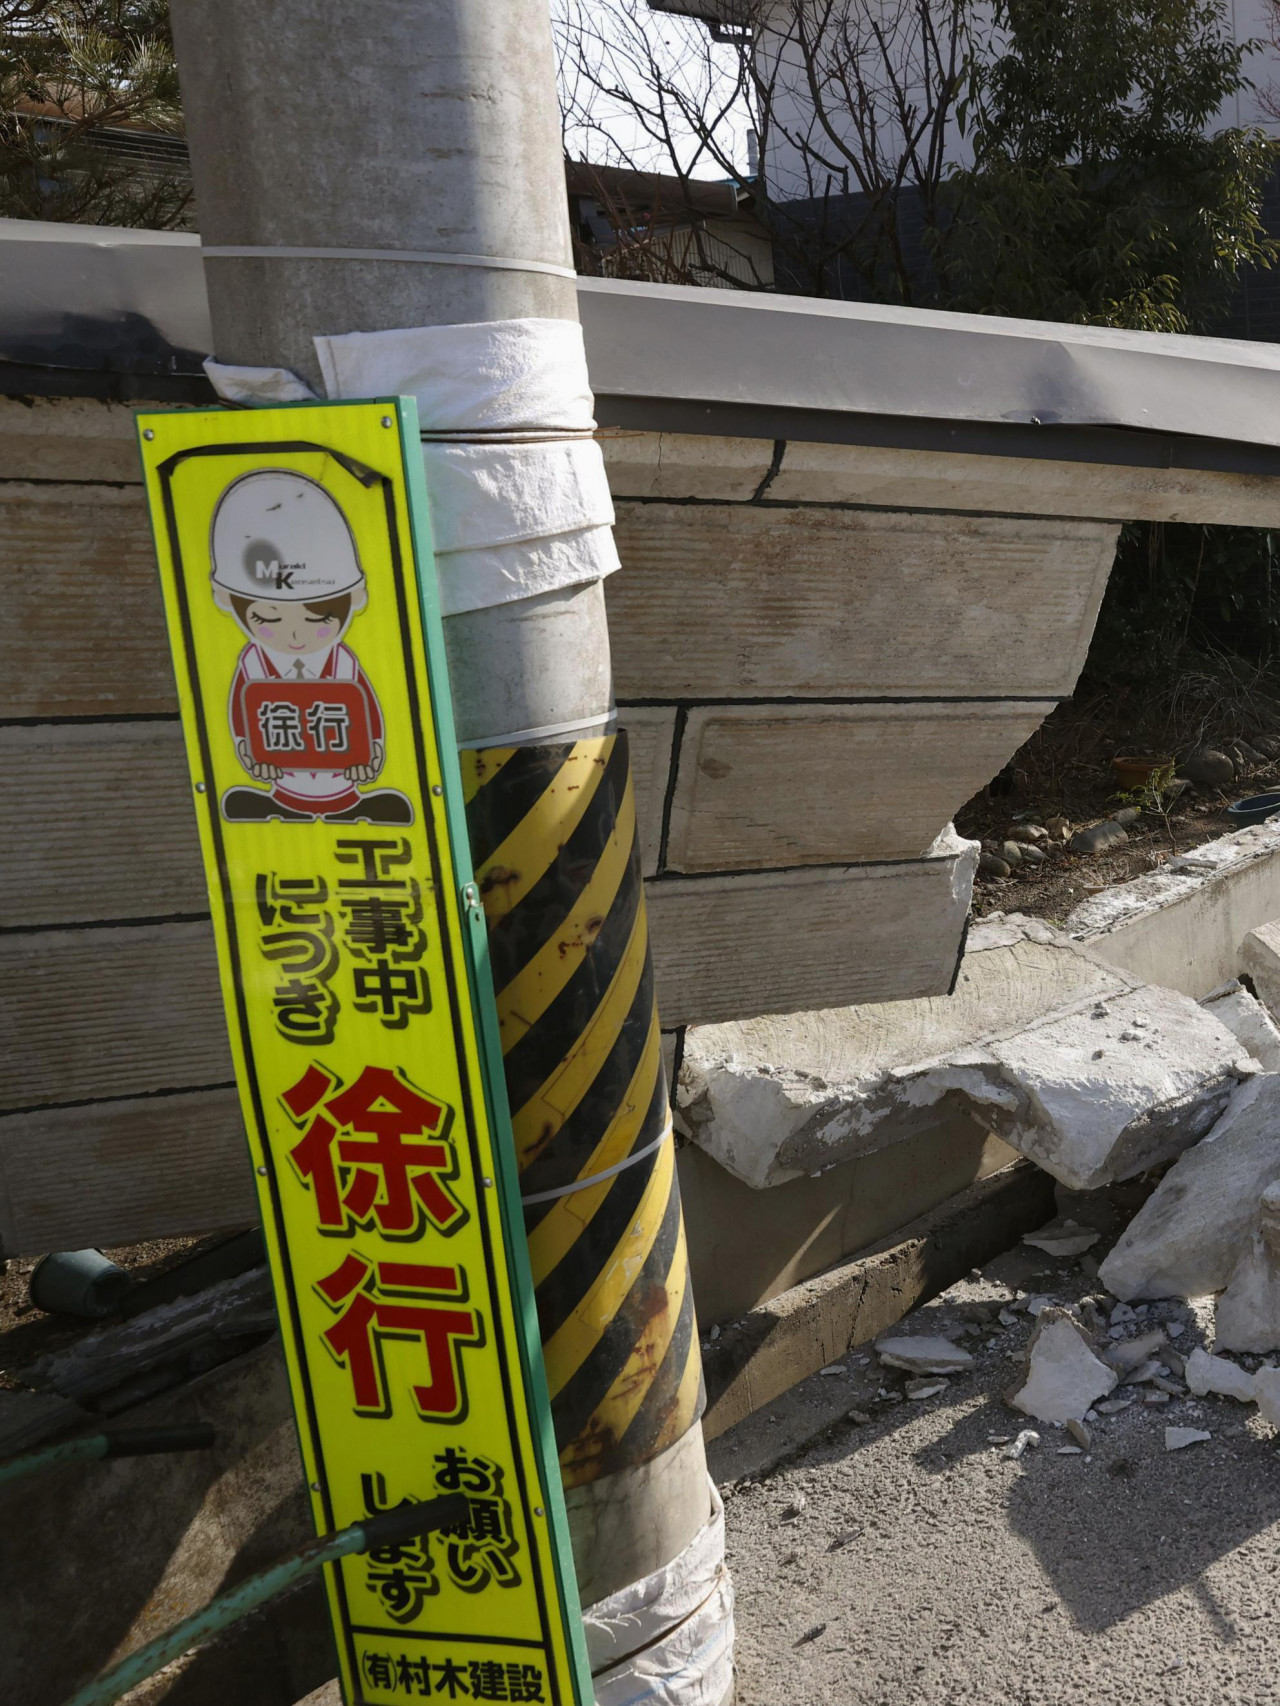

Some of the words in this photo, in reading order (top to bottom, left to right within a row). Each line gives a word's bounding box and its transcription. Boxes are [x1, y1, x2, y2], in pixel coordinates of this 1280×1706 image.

[258, 701, 349, 752] 徐行
[255, 872, 336, 1038] につき
[335, 838, 425, 1020] 工事中
[279, 1061, 482, 1419] 徐行
